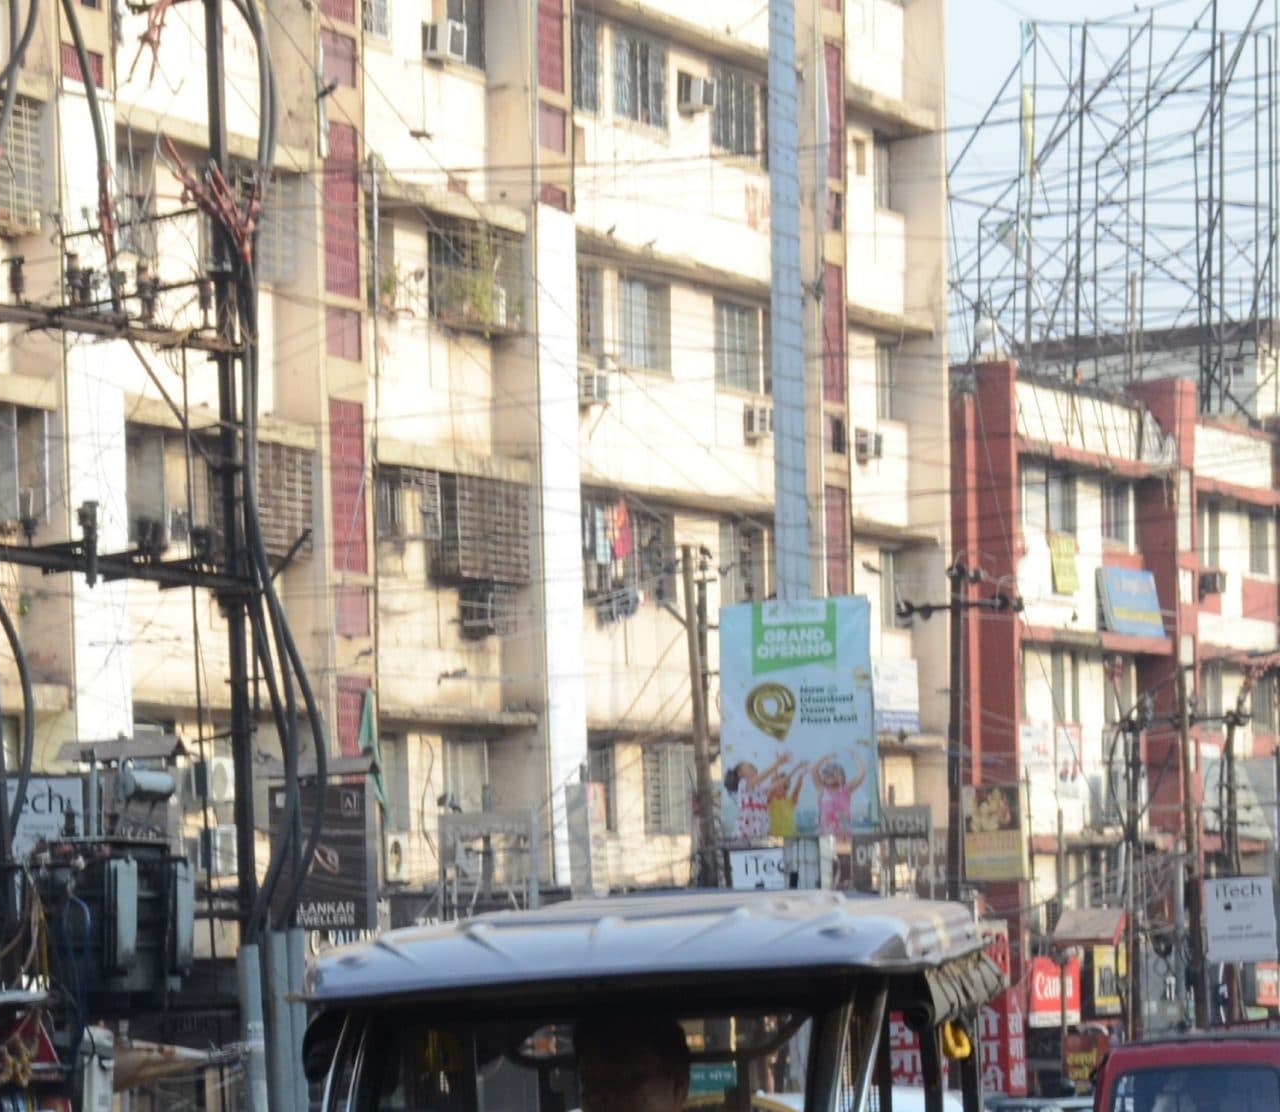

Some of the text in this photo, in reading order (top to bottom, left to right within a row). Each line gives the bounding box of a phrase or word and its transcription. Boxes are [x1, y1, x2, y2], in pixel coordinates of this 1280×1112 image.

[763, 627, 825, 643] GRAND
[756, 642, 833, 659] OPENING
[1215, 881, 1262, 899] iTech
[297, 913, 355, 926] EWELLERS
[1035, 971, 1073, 1000] Cann
